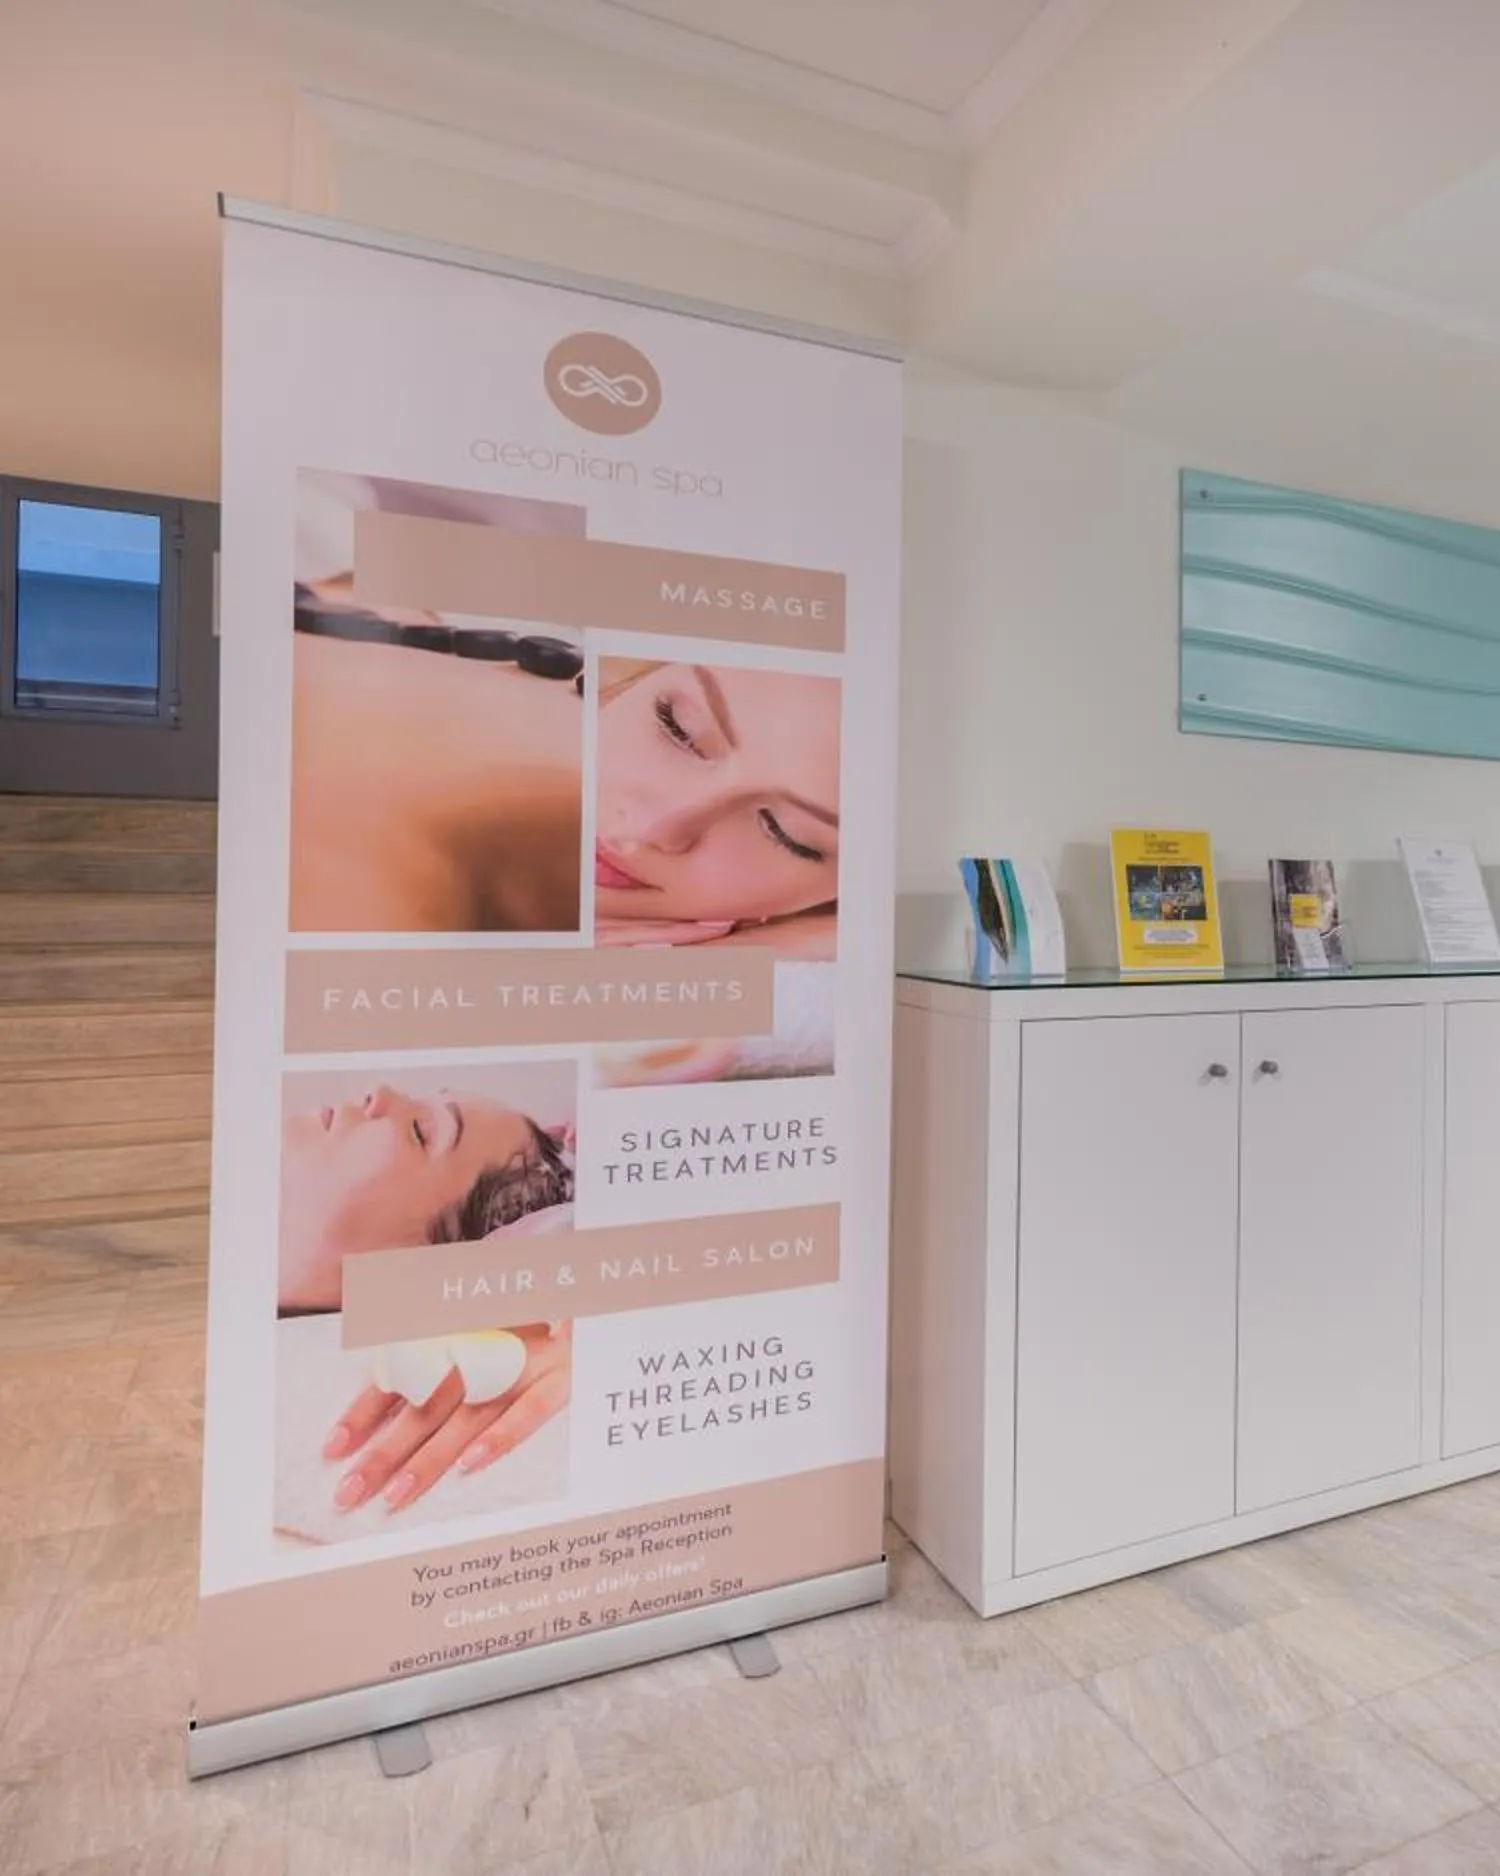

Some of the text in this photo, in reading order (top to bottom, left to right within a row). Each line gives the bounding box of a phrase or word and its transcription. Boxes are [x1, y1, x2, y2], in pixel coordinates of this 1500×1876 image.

[470, 436, 724, 499] aeonian spa
[660, 580, 828, 620] MASSAGE
[323, 980, 745, 1011] FACIAL TREATMENTS
[620, 1117, 826, 1152] SIGNATURE
[603, 1145, 838, 1185] TREATMENTS
[442, 1236, 816, 1300] HAIR & NAIL SALON
[638, 1336, 785, 1376] WAXING
[606, 1360, 815, 1414] THREADING
[607, 1391, 812, 1447] EYELASHES
[410, 1524, 733, 1608] by contacting the Spa Reception
[412, 1503, 732, 1583] You may book your appointment
[388, 1625, 535, 1674] aeonianspa.gr
[578, 1610, 593, 1627] &
[628, 1585, 704, 1616] Aeonian
[709, 1576, 745, 1598] Spa
